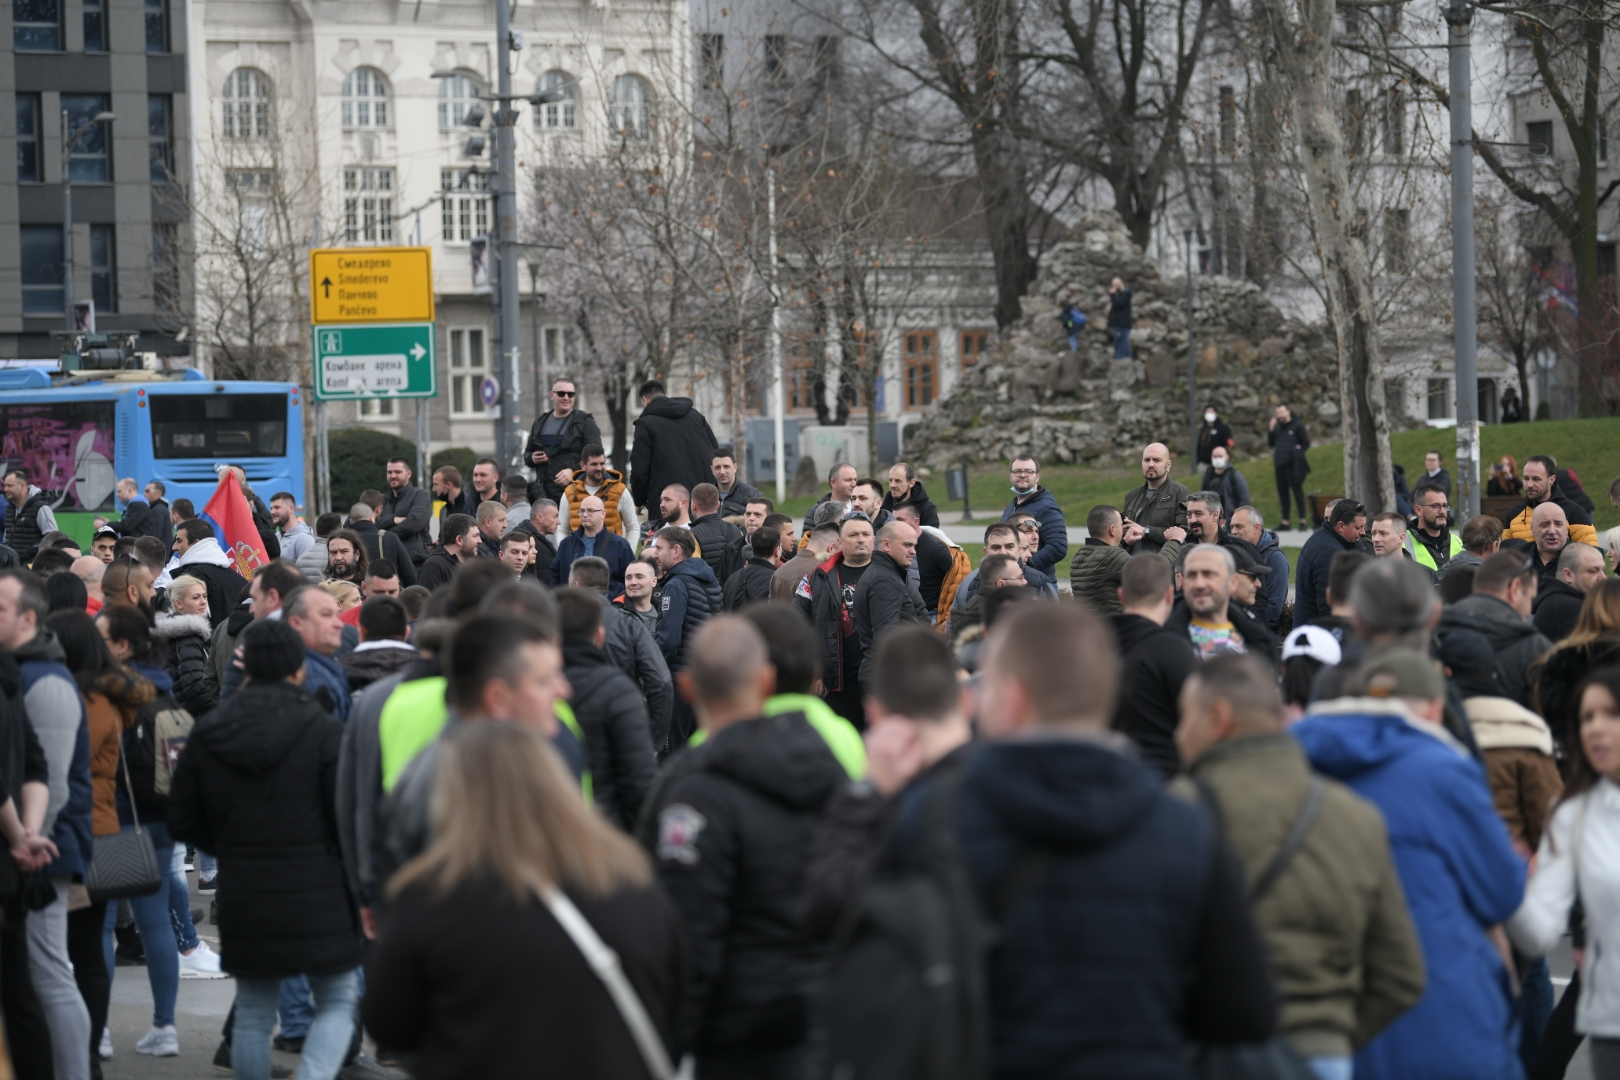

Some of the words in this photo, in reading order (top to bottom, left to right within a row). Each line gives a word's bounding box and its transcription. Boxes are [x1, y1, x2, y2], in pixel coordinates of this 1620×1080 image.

[338, 257, 391, 271] Смедерево
[338, 273, 388, 285] Smederevo
[338, 289, 378, 300] Панчево
[339, 304, 377, 316] Pančevo
[325, 360, 366, 371] Комбанк
[375, 361, 402, 372] арена
[376, 377, 402, 386] arena
